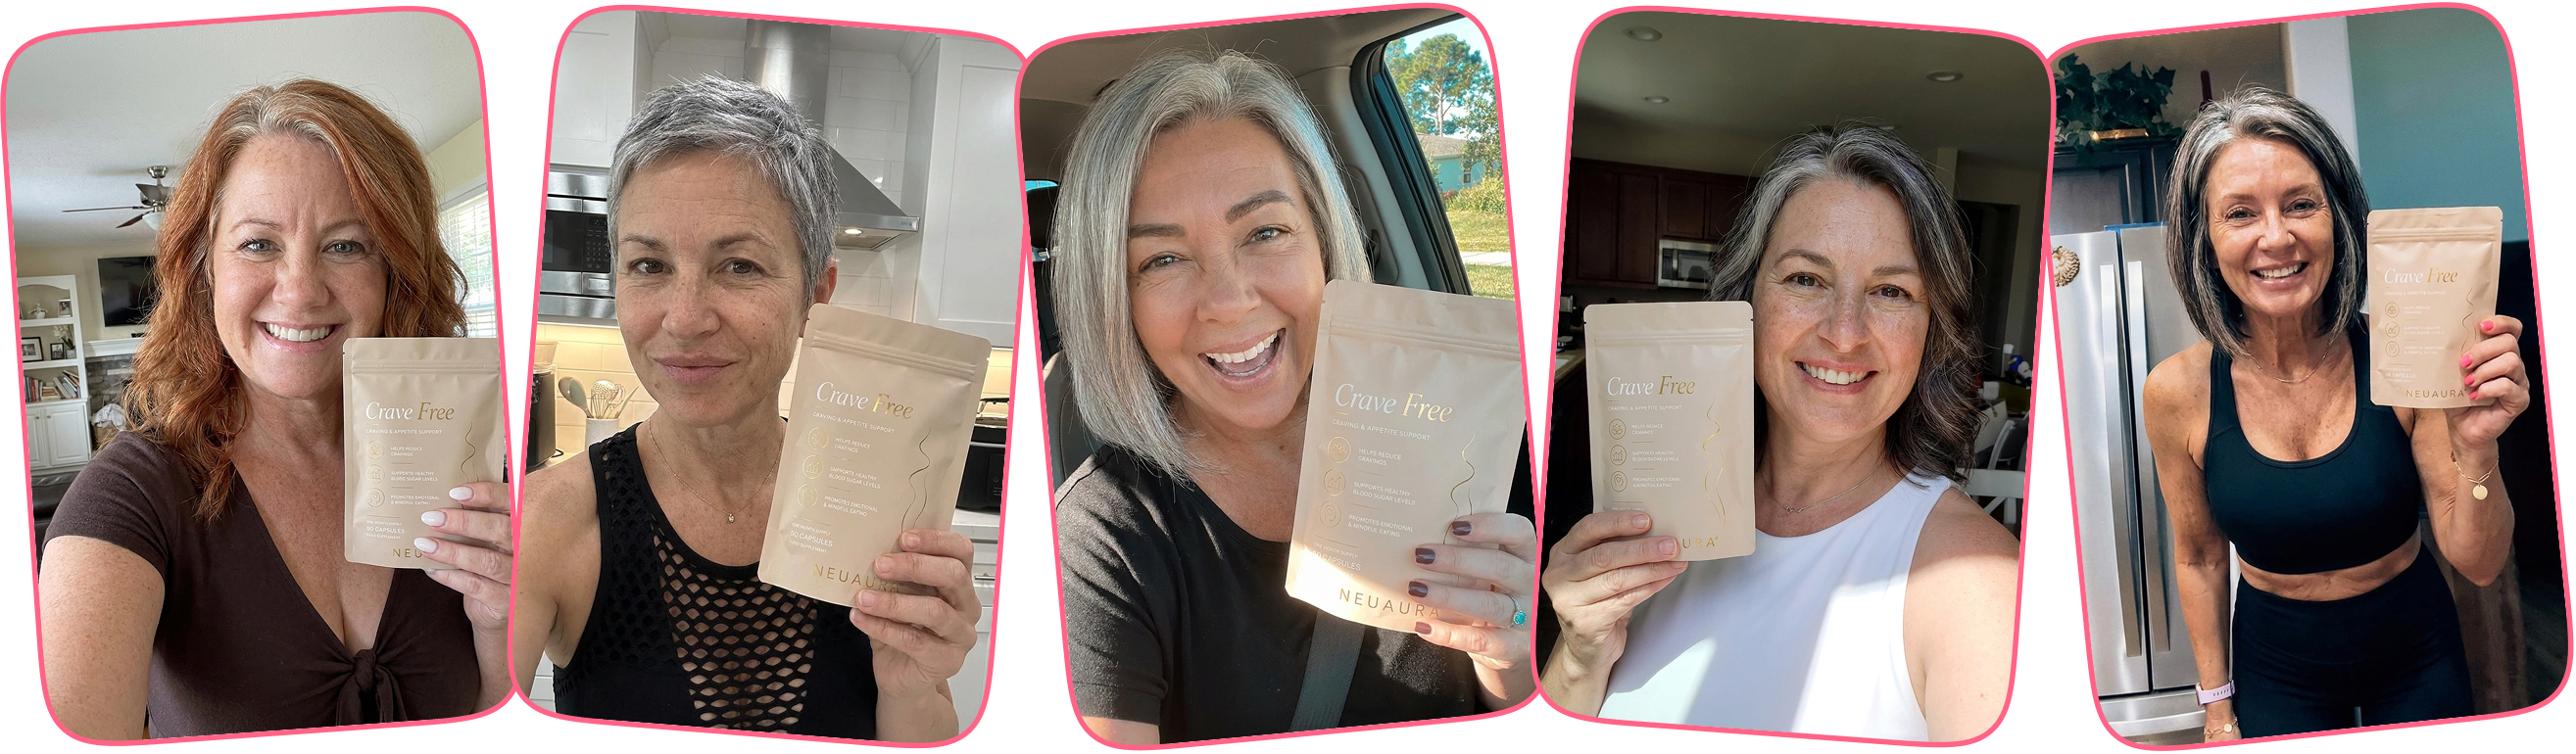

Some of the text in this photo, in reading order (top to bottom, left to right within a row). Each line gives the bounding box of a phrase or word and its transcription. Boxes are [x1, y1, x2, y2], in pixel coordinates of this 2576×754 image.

[2384, 267, 2458, 284] Crave Free
[1608, 375, 1695, 396] Crave Free
[816, 381, 914, 419] Crave Free
[1335, 383, 1453, 423] Crave Free
[365, 401, 455, 420] Crave Free
[843, 418, 868, 429] APPETITE
[870, 424, 895, 434] SUPPORT
[1332, 419, 1359, 429] CRAVING
[1367, 425, 1398, 436] APPETITE
[1399, 431, 1431, 441] SUPPORT
[1358, 456, 1387, 466] CRAVINGS
[1378, 451, 1402, 460] REDUCE
[863, 481, 881, 490] LEVELS
[1353, 481, 1411, 496] SUPPORTS HEALTHY
[1393, 496, 1416, 505] LEVELS
[1348, 515, 1414, 532] PROMOTES EMOTIONAL
[1353, 523, 1379, 533] MINDFUL
[1380, 529, 1400, 538] EATING
[800, 533, 833, 546] CAPSULES
[1323, 553, 1361, 571] CAPSULES
[1338, 588, 1439, 617] NEUAURA
